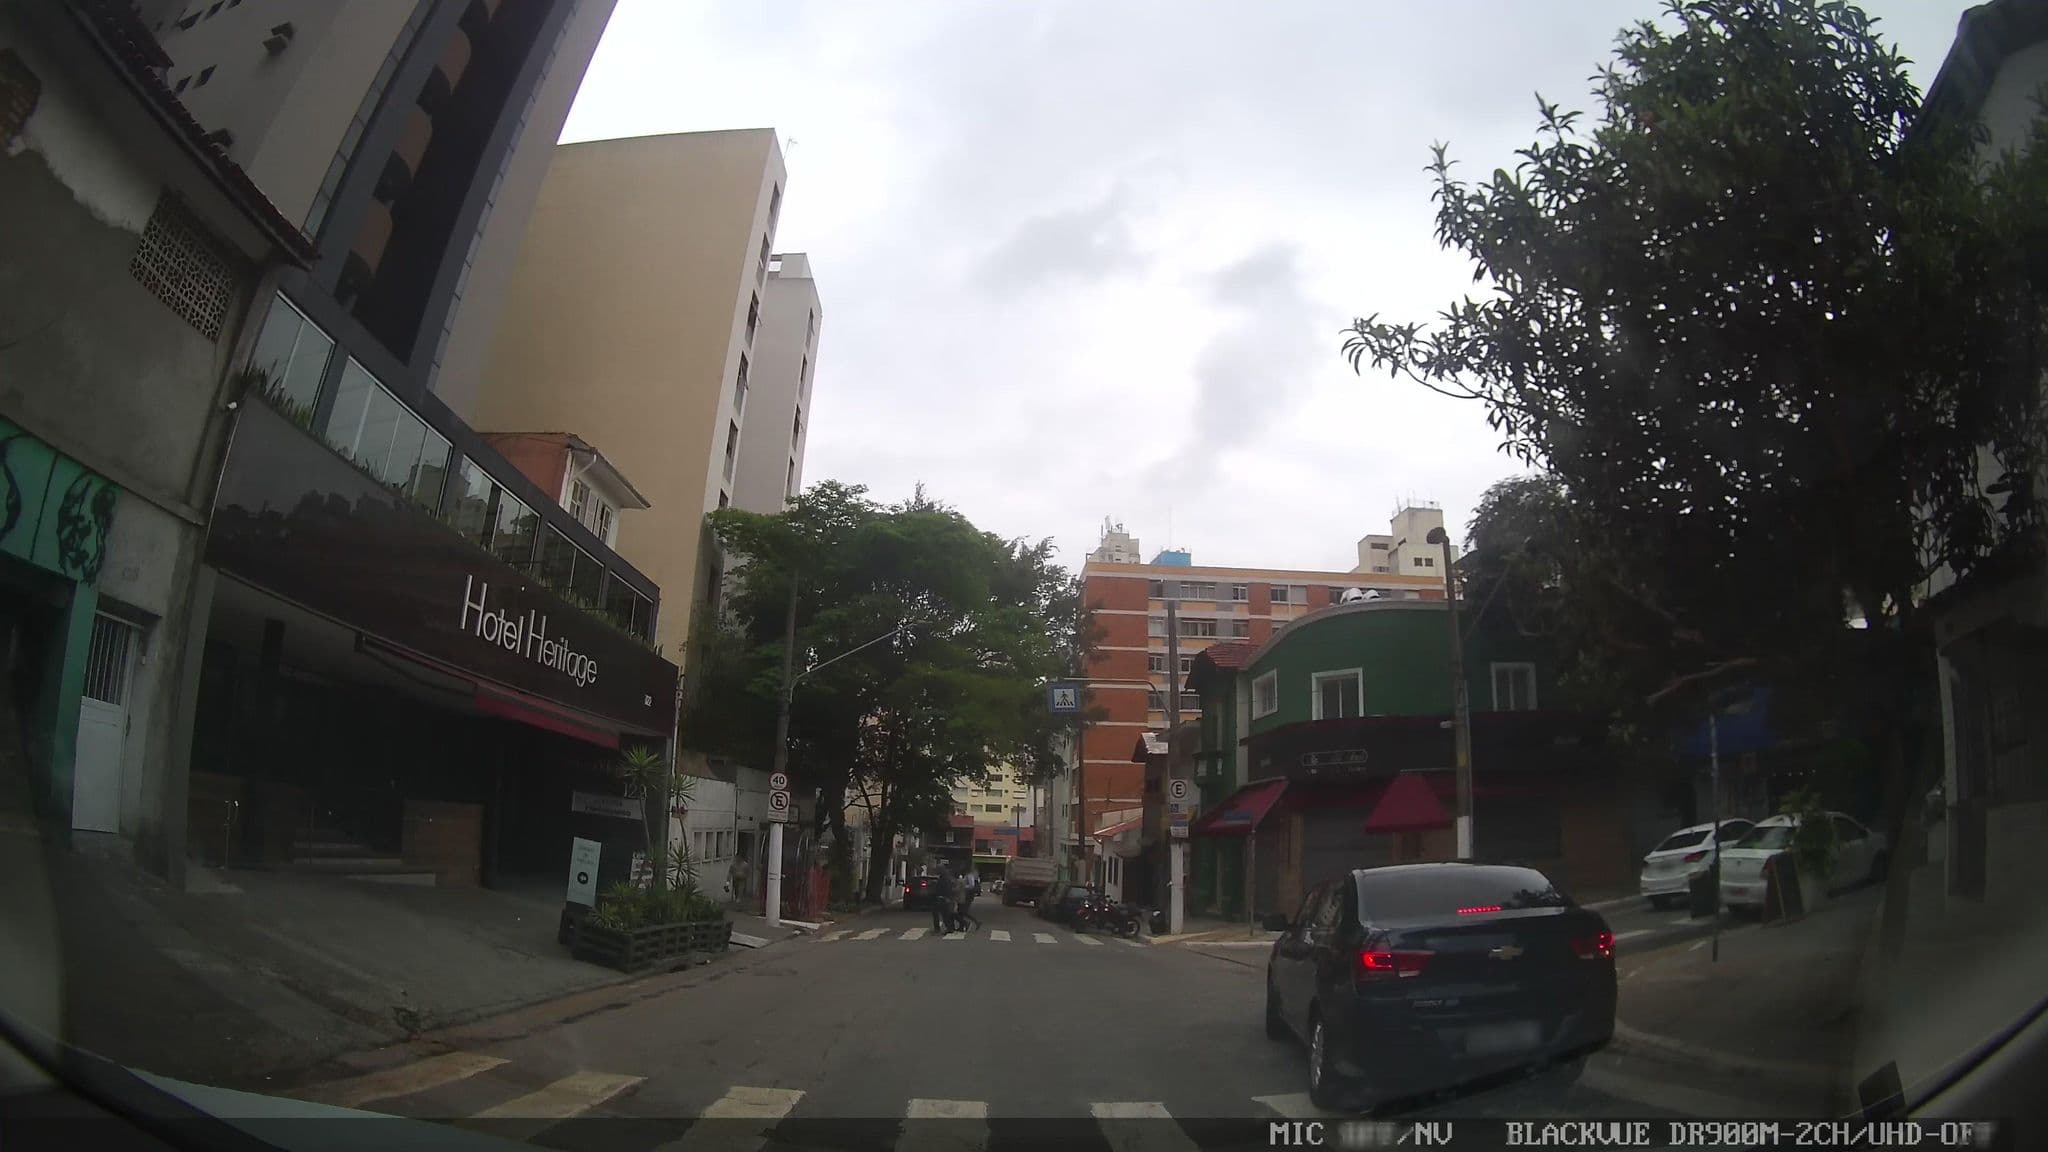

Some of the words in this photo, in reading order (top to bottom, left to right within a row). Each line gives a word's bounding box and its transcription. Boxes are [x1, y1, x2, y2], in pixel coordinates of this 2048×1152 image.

[460, 574, 524, 653] Hotel
[527, 608, 598, 688] Heritage
[773, 776, 785, 785] 40
[1175, 784, 1183, 795] E
